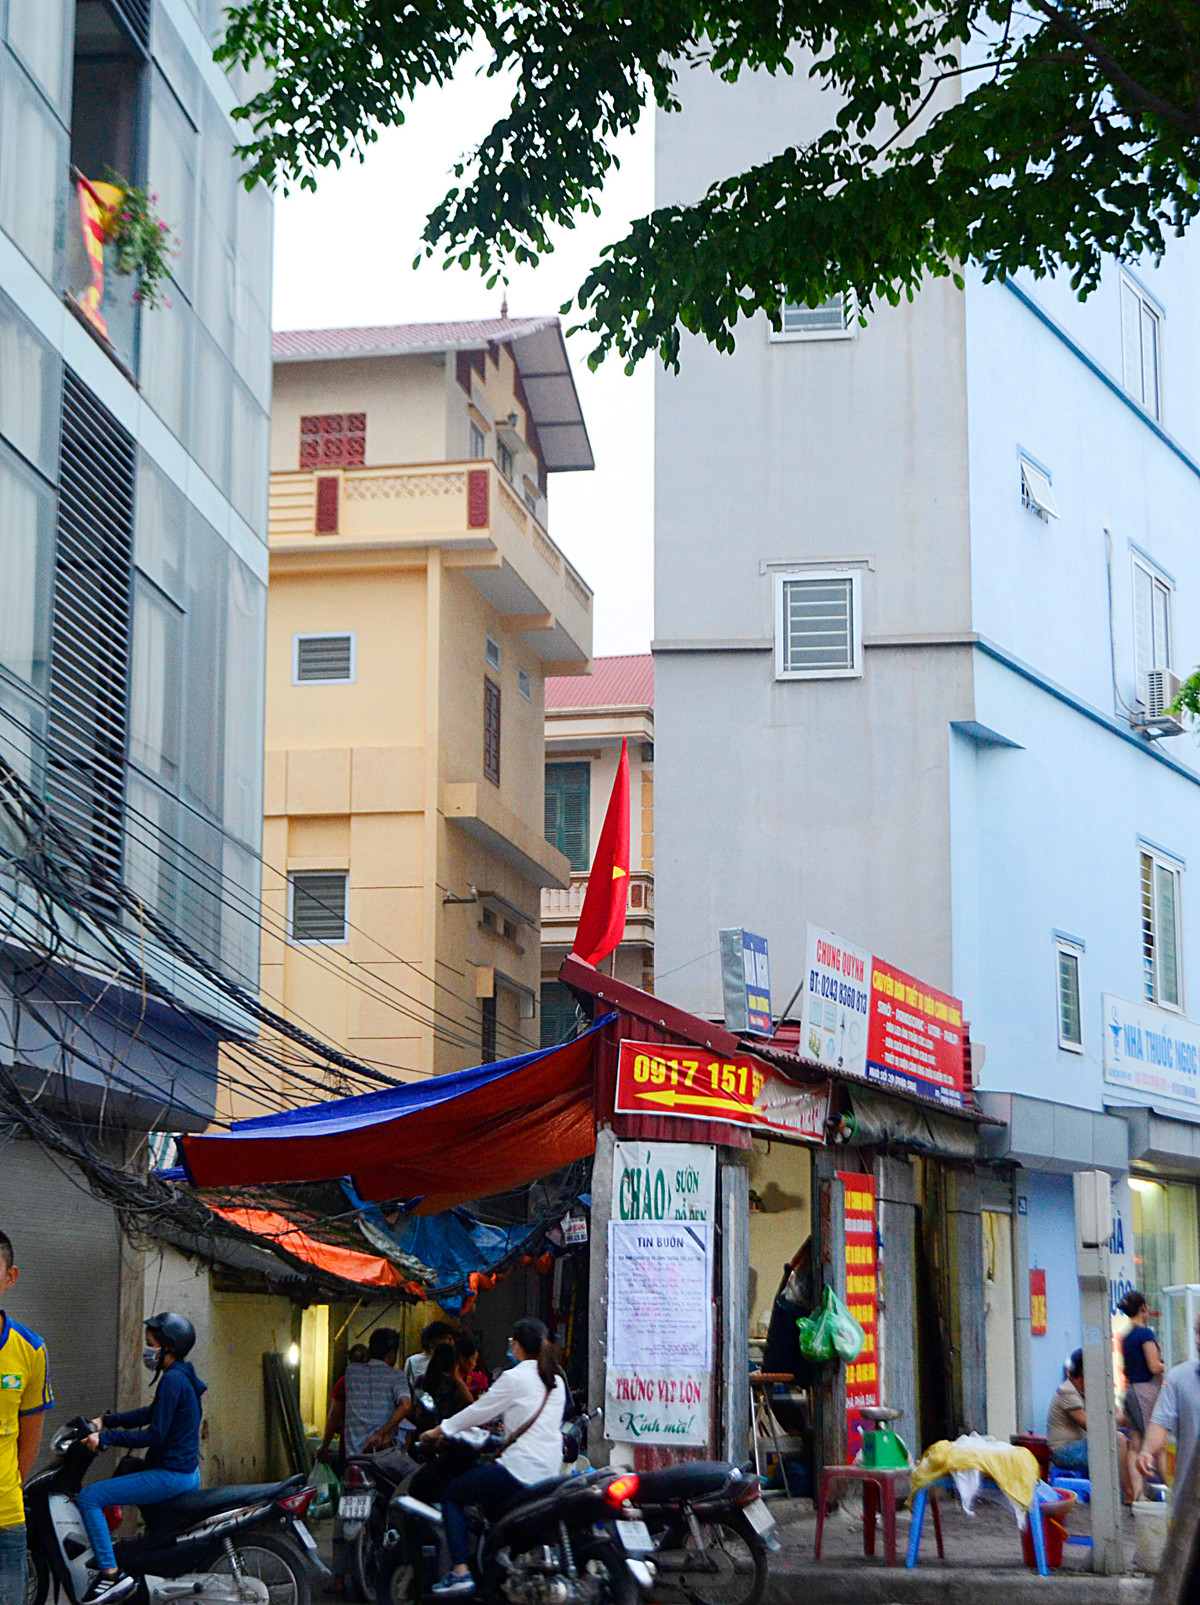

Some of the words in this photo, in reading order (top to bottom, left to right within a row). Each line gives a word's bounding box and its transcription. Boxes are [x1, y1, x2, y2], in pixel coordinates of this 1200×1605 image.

[816, 939, 840, 971] CHUNG
[842, 951, 864, 982] QUỲNH
[810, 970, 820, 994] ĐT:
[821, 975, 838, 1002] 0243
[839, 982, 856, 1009] 8360
[856, 990, 868, 1014] 813
[1124, 1020, 1143, 1061] NHÀ
[1145, 1024, 1172, 1069] THUỐC
[1175, 1040, 1197, 1081] NGỌC
[634, 1054, 698, 1086] 0917
[708, 1062, 748, 1095] 151
[620, 1150, 666, 1220] CHÁO
[676, 1164, 699, 1193] SƯỜN
[637, 1236, 653, 1248] TIN
[616, 1372, 654, 1402] TRỨNG
[658, 1380, 676, 1408] VỊT
[679, 1374, 702, 1410] LỘN
[619, 1412, 660, 1437] Kính
[664, 1414, 696, 1434] mời!
